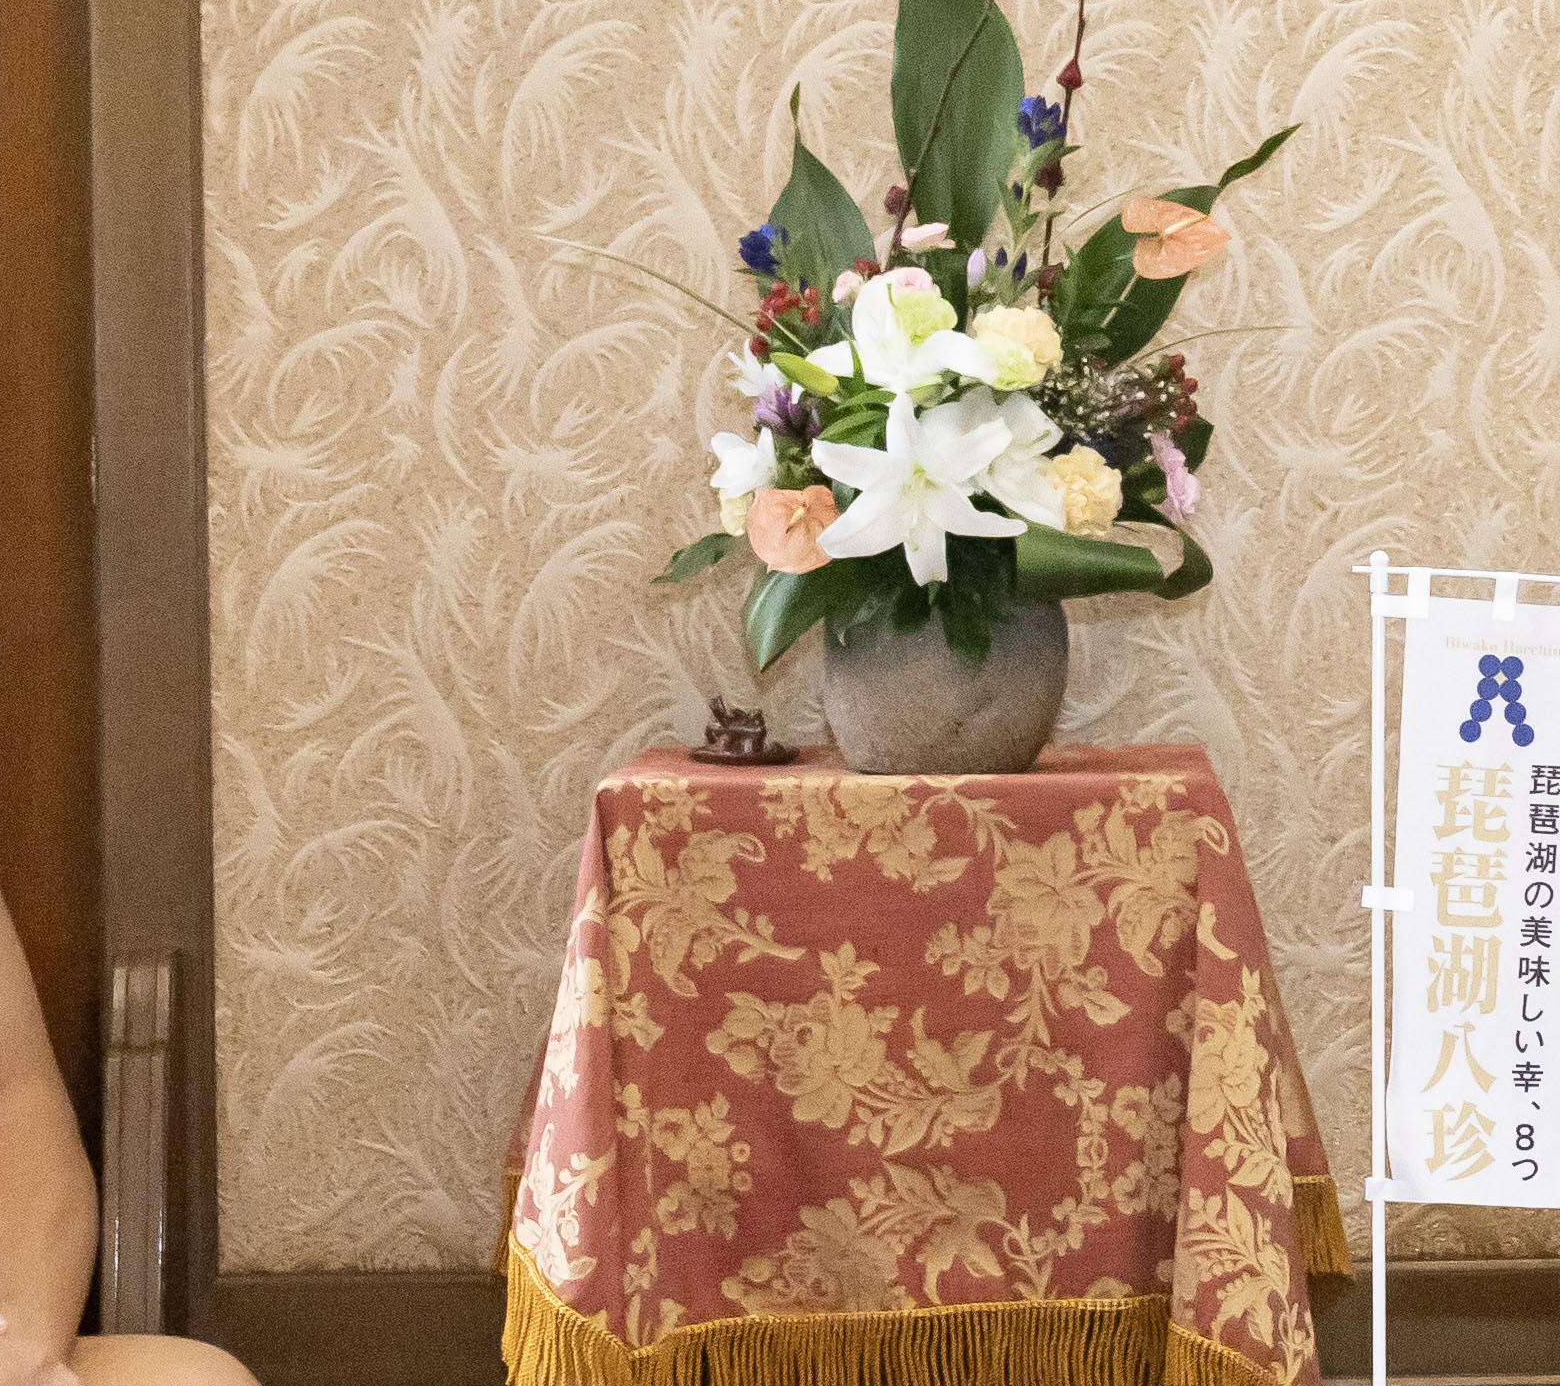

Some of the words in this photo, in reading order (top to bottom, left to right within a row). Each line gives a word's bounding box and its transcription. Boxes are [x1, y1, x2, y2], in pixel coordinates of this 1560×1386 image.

[1419, 760, 1515, 1182] 琵琶湖八珍
